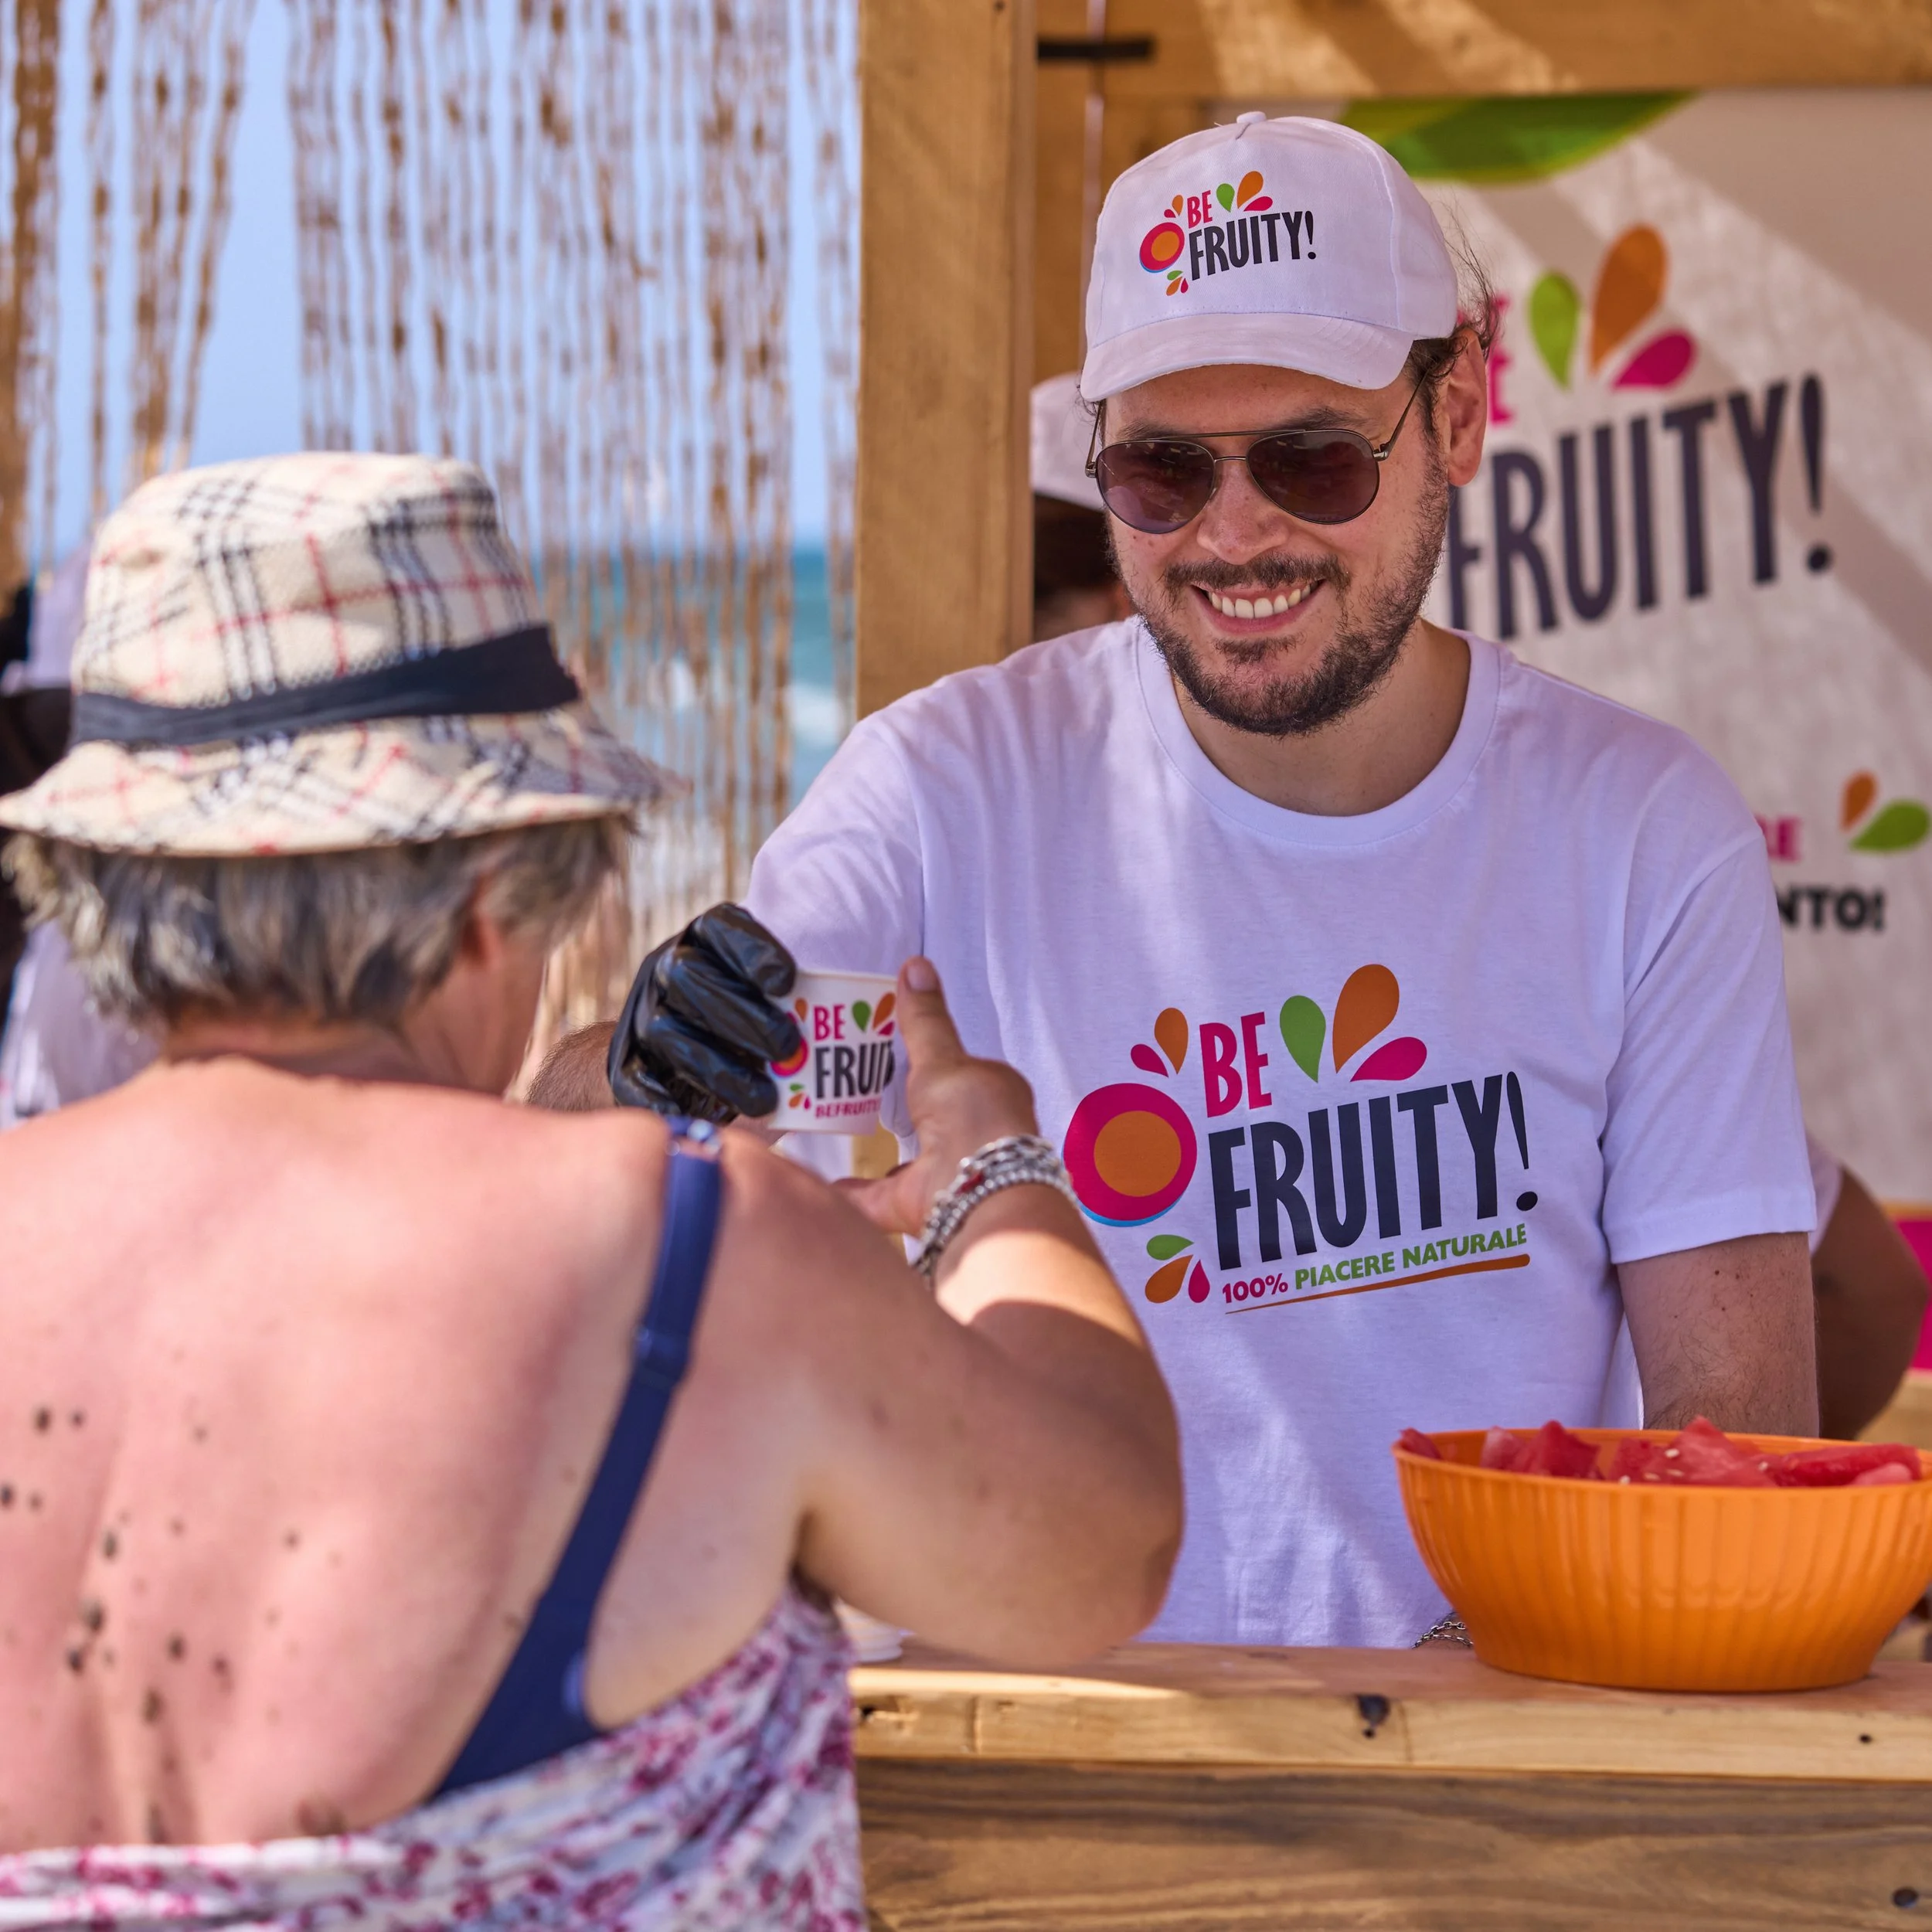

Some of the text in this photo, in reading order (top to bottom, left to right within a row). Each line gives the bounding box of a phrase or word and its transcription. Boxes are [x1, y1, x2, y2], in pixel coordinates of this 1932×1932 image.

[1187, 189, 1213, 229] BE
[1189, 210, 1317, 281] FRUITY!
[814, 1004, 846, 1043] BE
[1199, 1011, 1273, 1118] BE
[1208, 1070, 1539, 1271] FRUITY!
[1222, 1223, 1527, 1304] 100% PIACERE NATURALE
